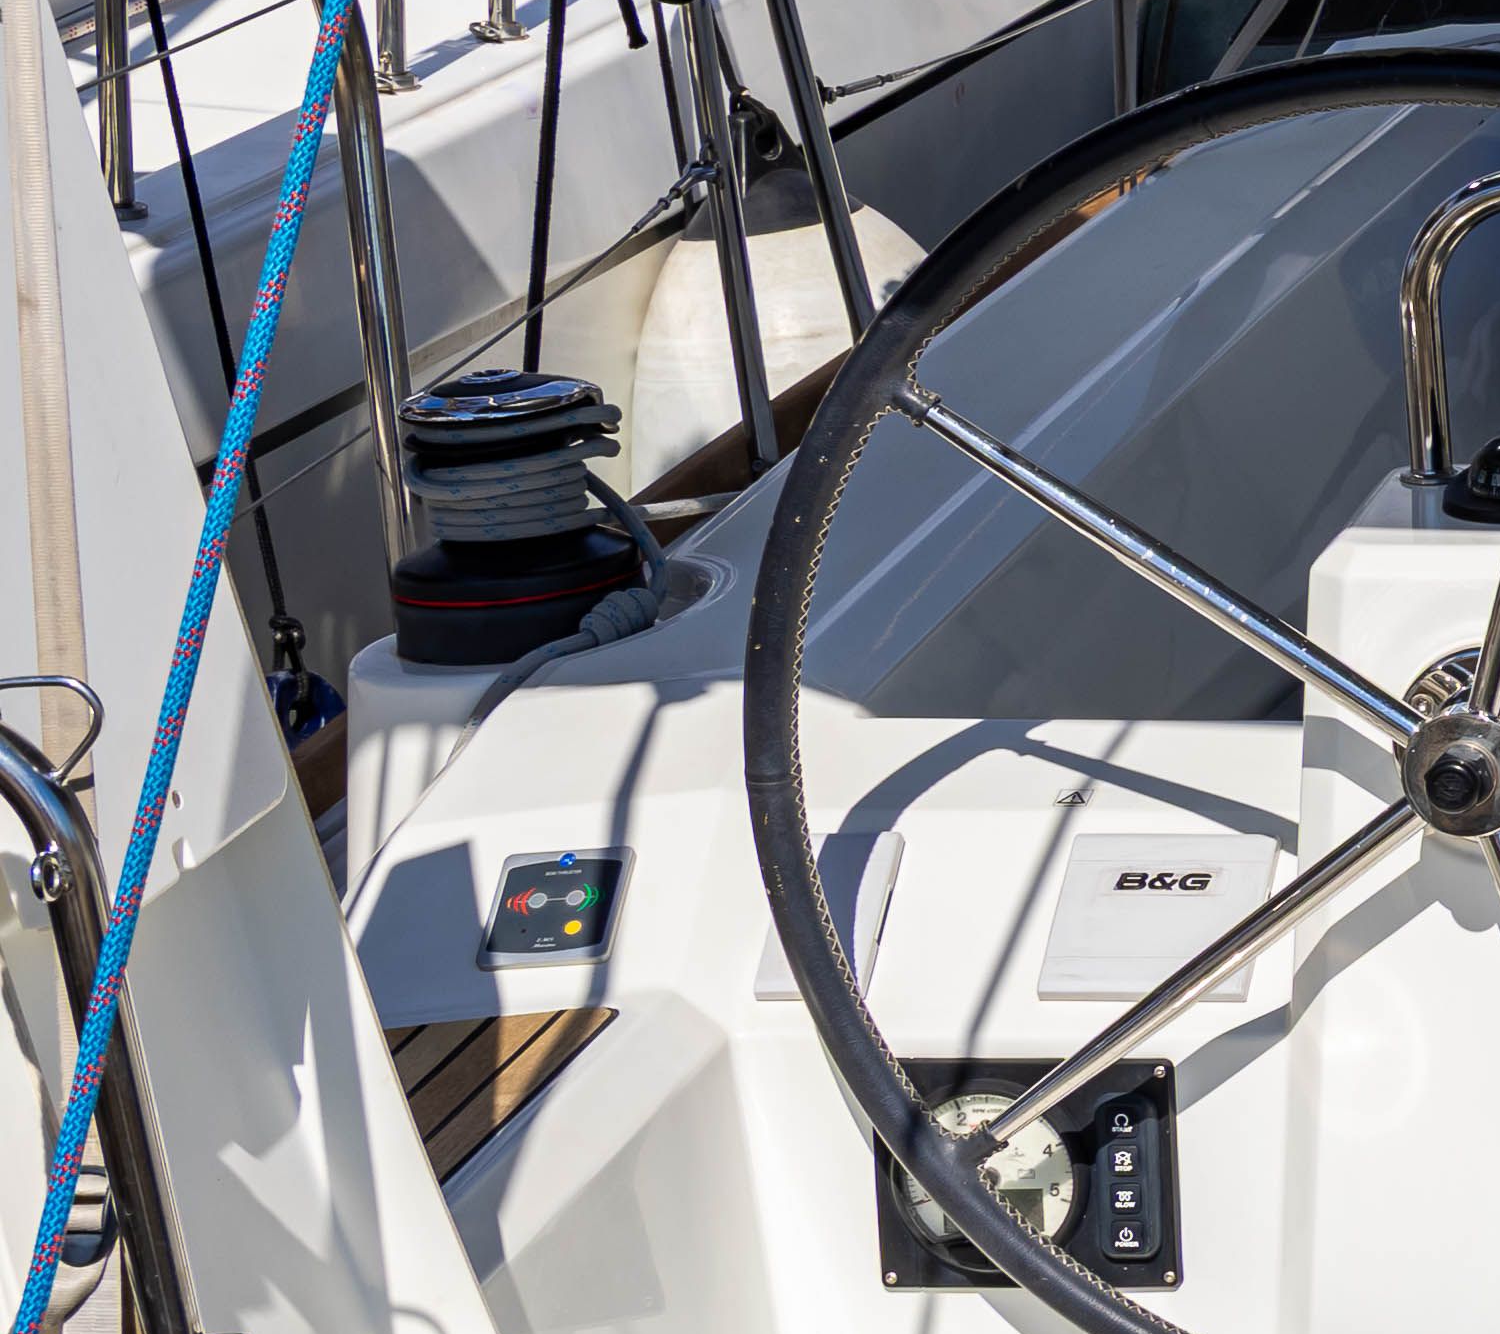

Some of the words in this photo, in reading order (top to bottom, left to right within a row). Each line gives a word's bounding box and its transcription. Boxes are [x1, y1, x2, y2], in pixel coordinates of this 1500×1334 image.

[1113, 872, 1213, 891] B&G
[956, 1114, 967, 1126] 2
[1112, 1125, 1133, 1133] START
[1042, 1143, 1054, 1157] 4
[1049, 1182, 1060, 1197] 5
[1114, 1201, 1136, 1209] GLOW
